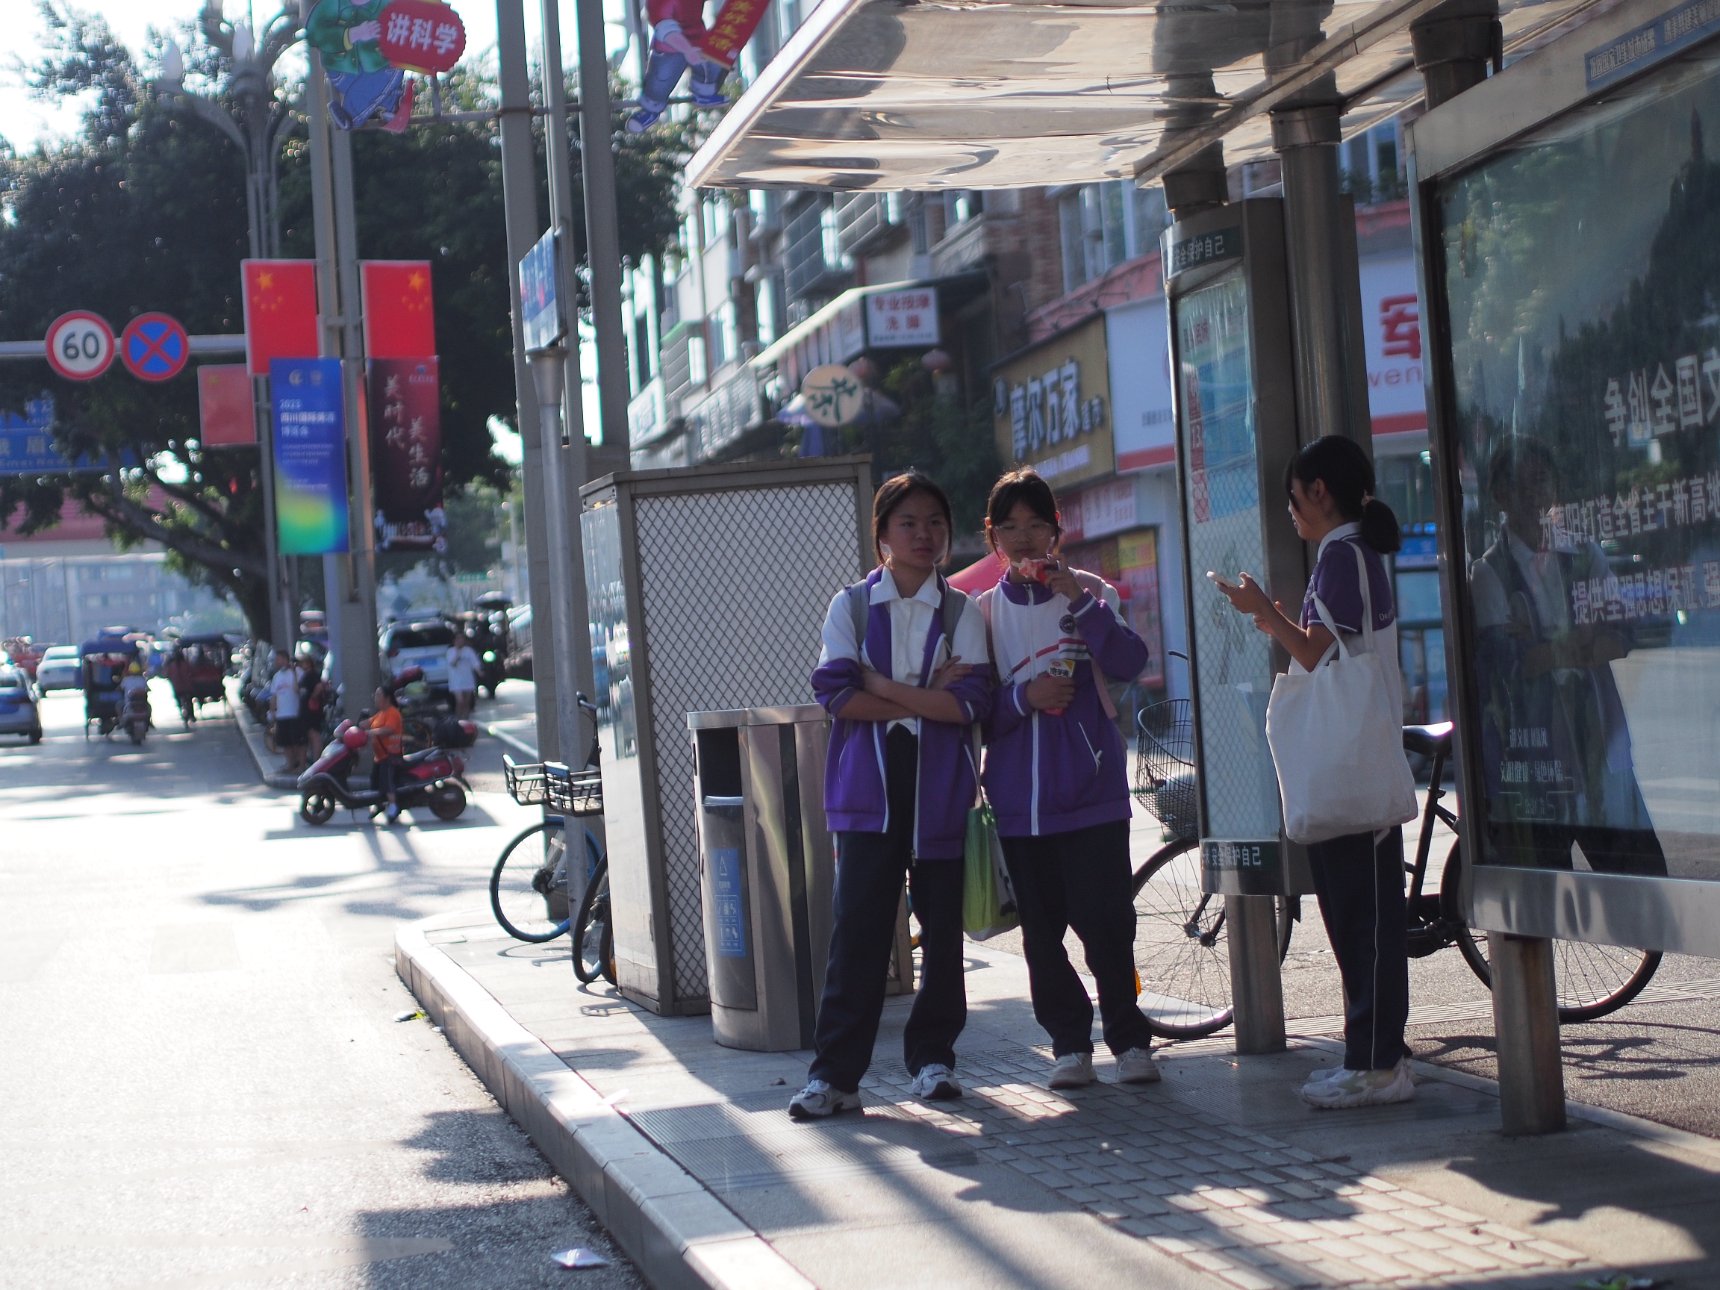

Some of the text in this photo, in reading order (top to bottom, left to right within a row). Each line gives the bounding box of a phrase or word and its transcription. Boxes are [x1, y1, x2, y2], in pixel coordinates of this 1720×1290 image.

[386, 12, 458, 55] 讲科学
[63, 331, 100, 360] 60
[1010, 358, 1080, 460] 摩尔万家
